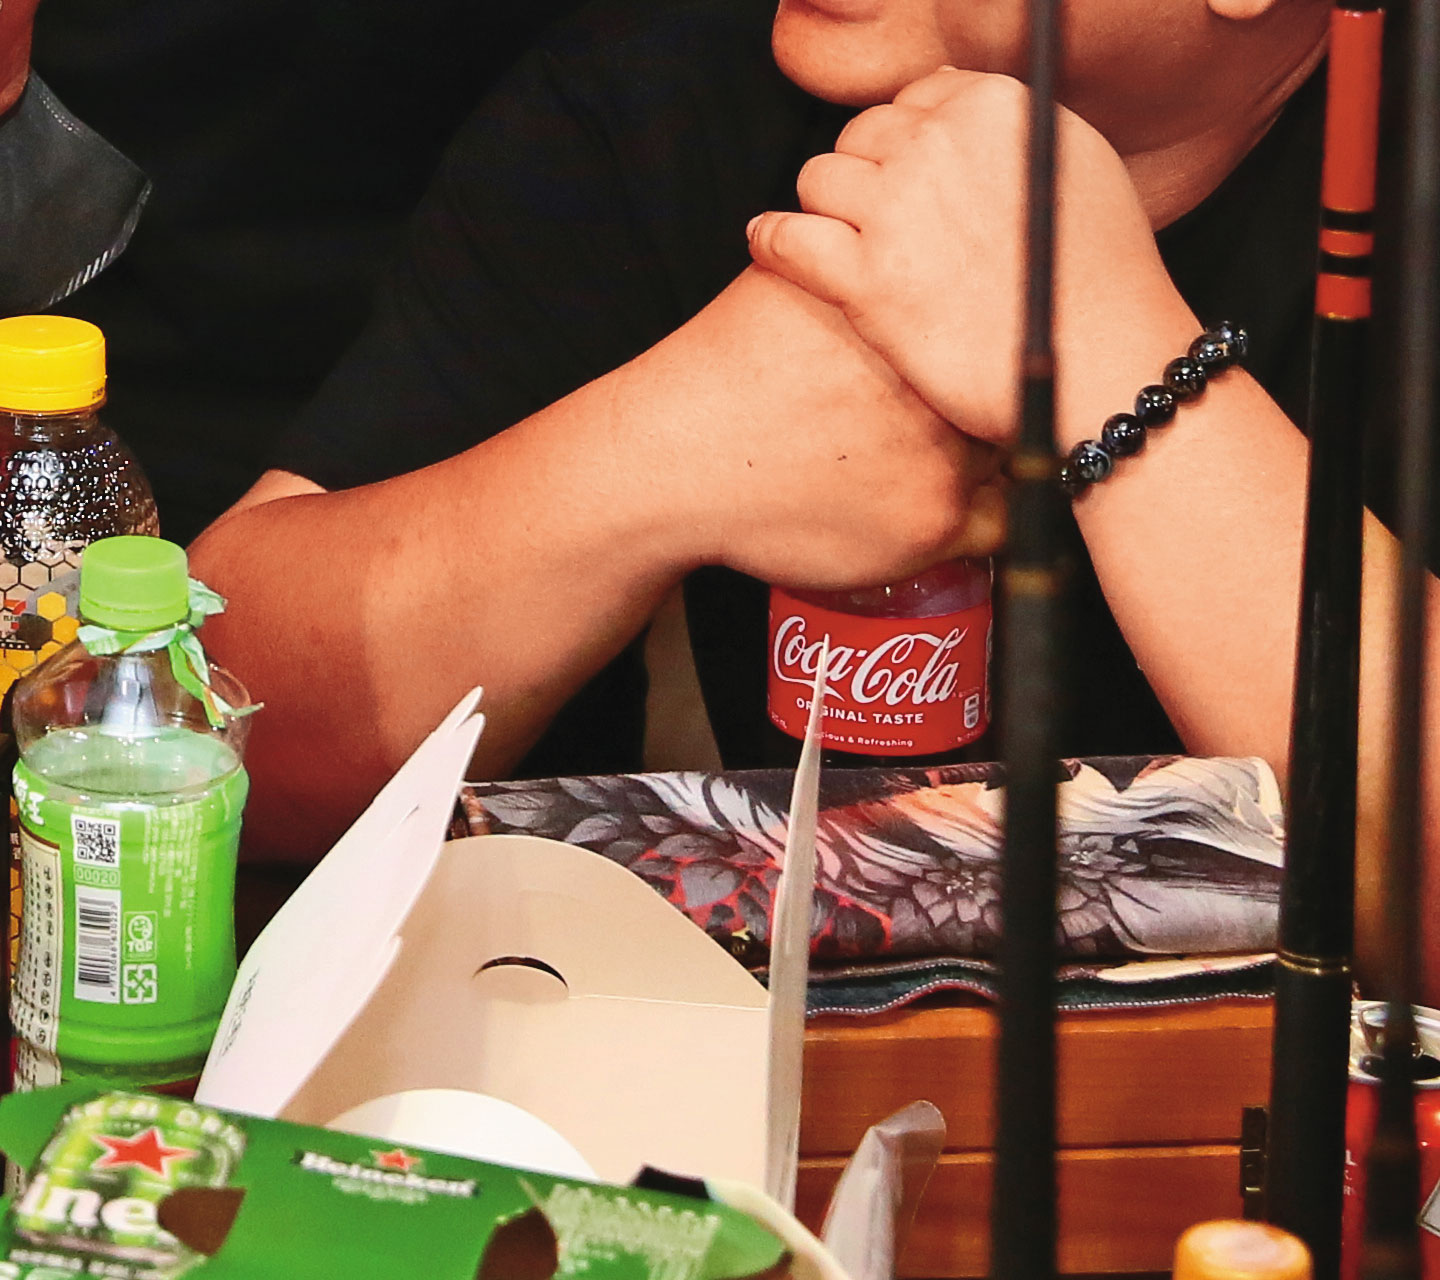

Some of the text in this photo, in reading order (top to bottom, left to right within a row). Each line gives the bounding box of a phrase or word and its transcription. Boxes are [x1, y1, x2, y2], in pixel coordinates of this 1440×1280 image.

[773, 615, 969, 706] Coca-Cola
[796, 697, 925, 726] ORGINAL TASTE
[857, 736, 914, 748] Refreshing
[127, 941, 154, 954] TQF
